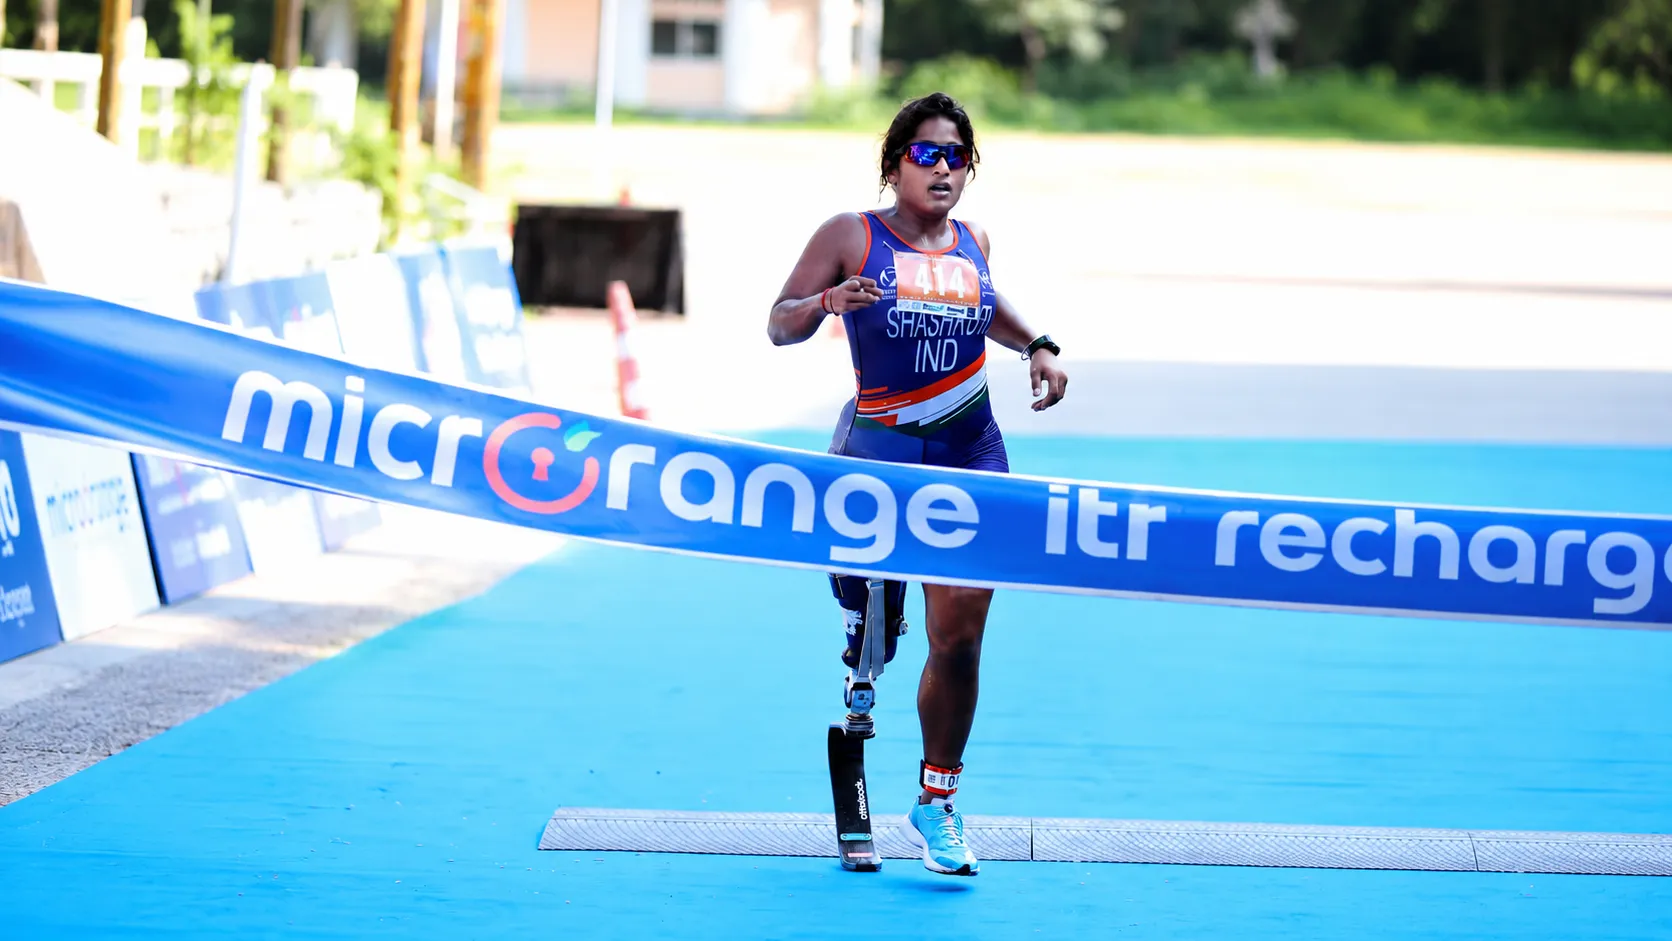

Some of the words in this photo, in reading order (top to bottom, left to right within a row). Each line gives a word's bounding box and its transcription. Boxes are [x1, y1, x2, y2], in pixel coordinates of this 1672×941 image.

[914, 263, 966, 299] 414
[915, 339, 958, 373] IND
[1045, 483, 1167, 560] itr
[1214, 508, 1672, 614] recharg
